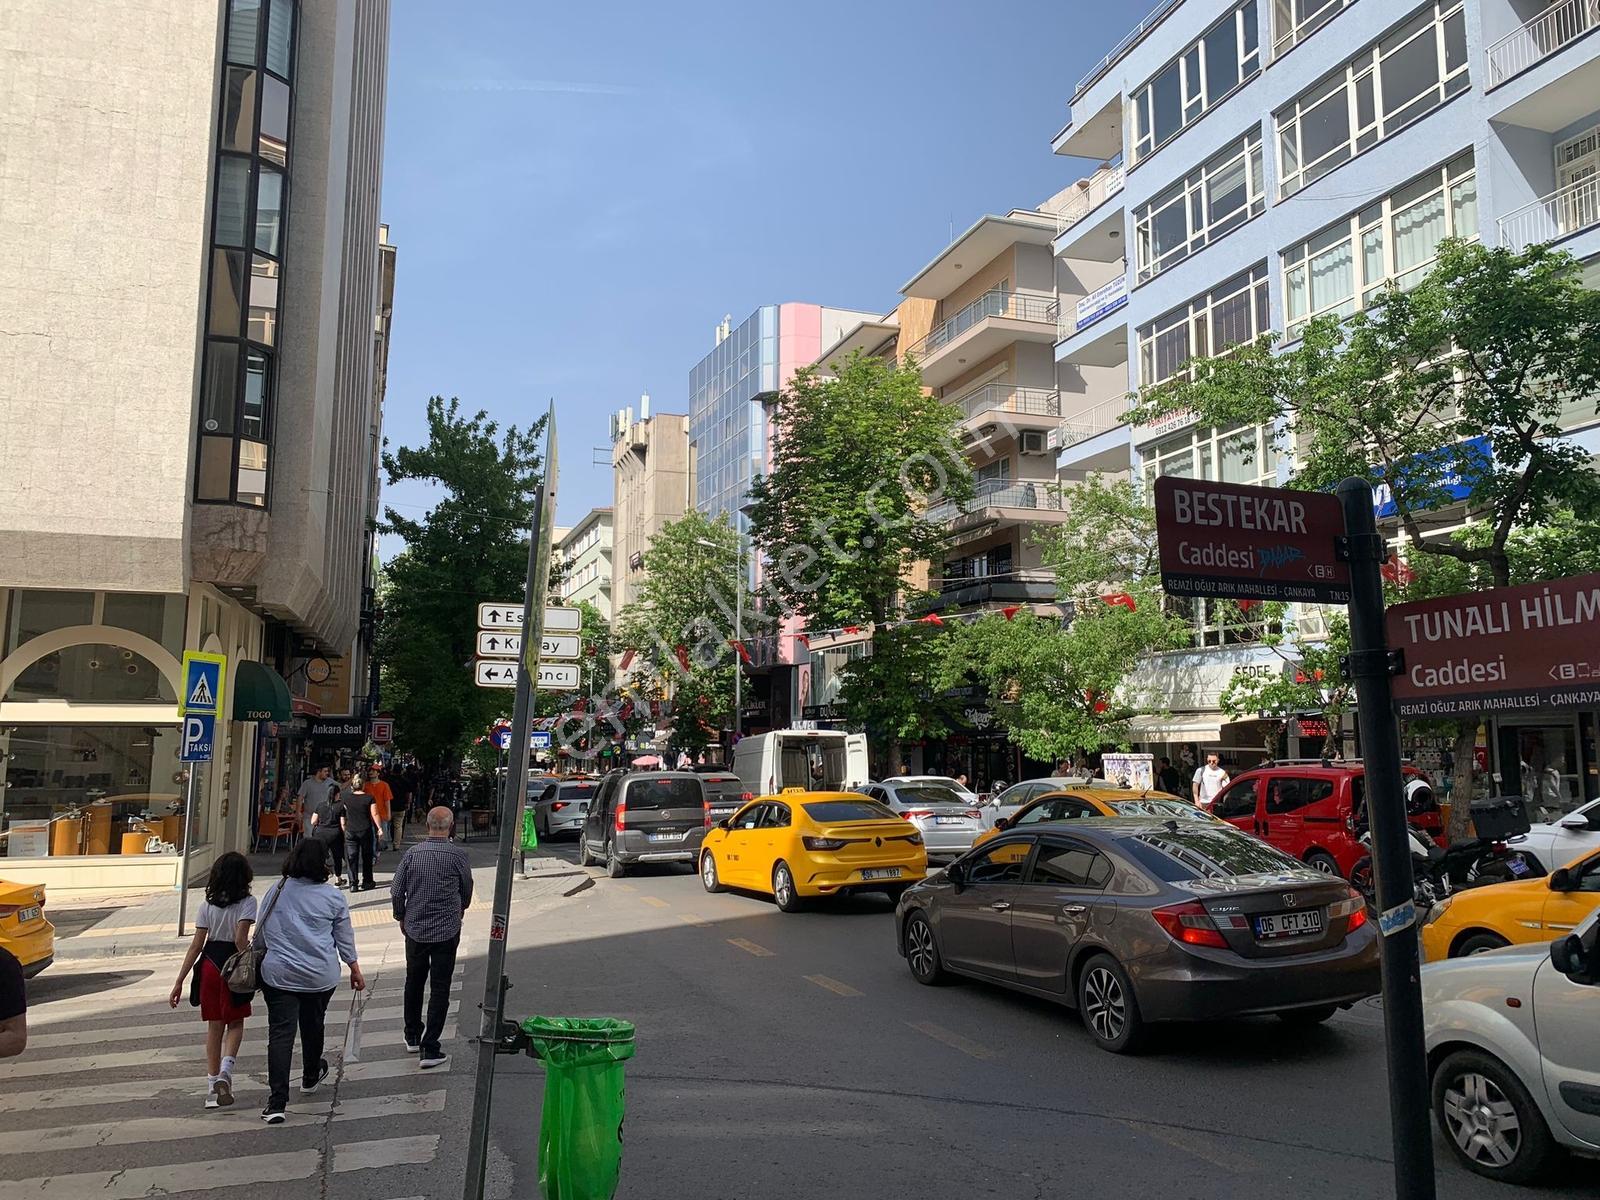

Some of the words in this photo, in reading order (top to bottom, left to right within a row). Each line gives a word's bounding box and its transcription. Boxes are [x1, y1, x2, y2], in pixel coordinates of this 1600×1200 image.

[1174, 489, 1307, 535] BESTEKAR
[1178, 541, 1255, 569] Caddesi
[1168, 578, 1194, 592] REMZİ
[1194, 580, 1217, 592] OĞUZ
[1218, 584, 1236, 593] ARIK
[1237, 583, 1278, 596] MAHALLESİ
[1284, 588, 1316, 599] ÇANKAYA
[1404, 601, 1511, 644] TUNALI
[1520, 587, 1600, 630] HİLM
[1411, 654, 1507, 688] Caddesi
[246, 710, 271, 719] TOGO
[1400, 700, 1428, 715] REMZİ
[1430, 699, 1457, 713] OĞUZ
[1458, 699, 1481, 712] ARIK
[1483, 692, 1540, 710] MAHALLESİ
[1550, 691, 1600, 706] ÇANKAYA
[184, 718, 204, 757] P
[312, 724, 342, 734] Ankara
[343, 723, 362, 734] Saat
[1260, 918, 1274, 932] 06
[1281, 914, 1300, 930] CFT
[1302, 911, 1320, 928] 310
